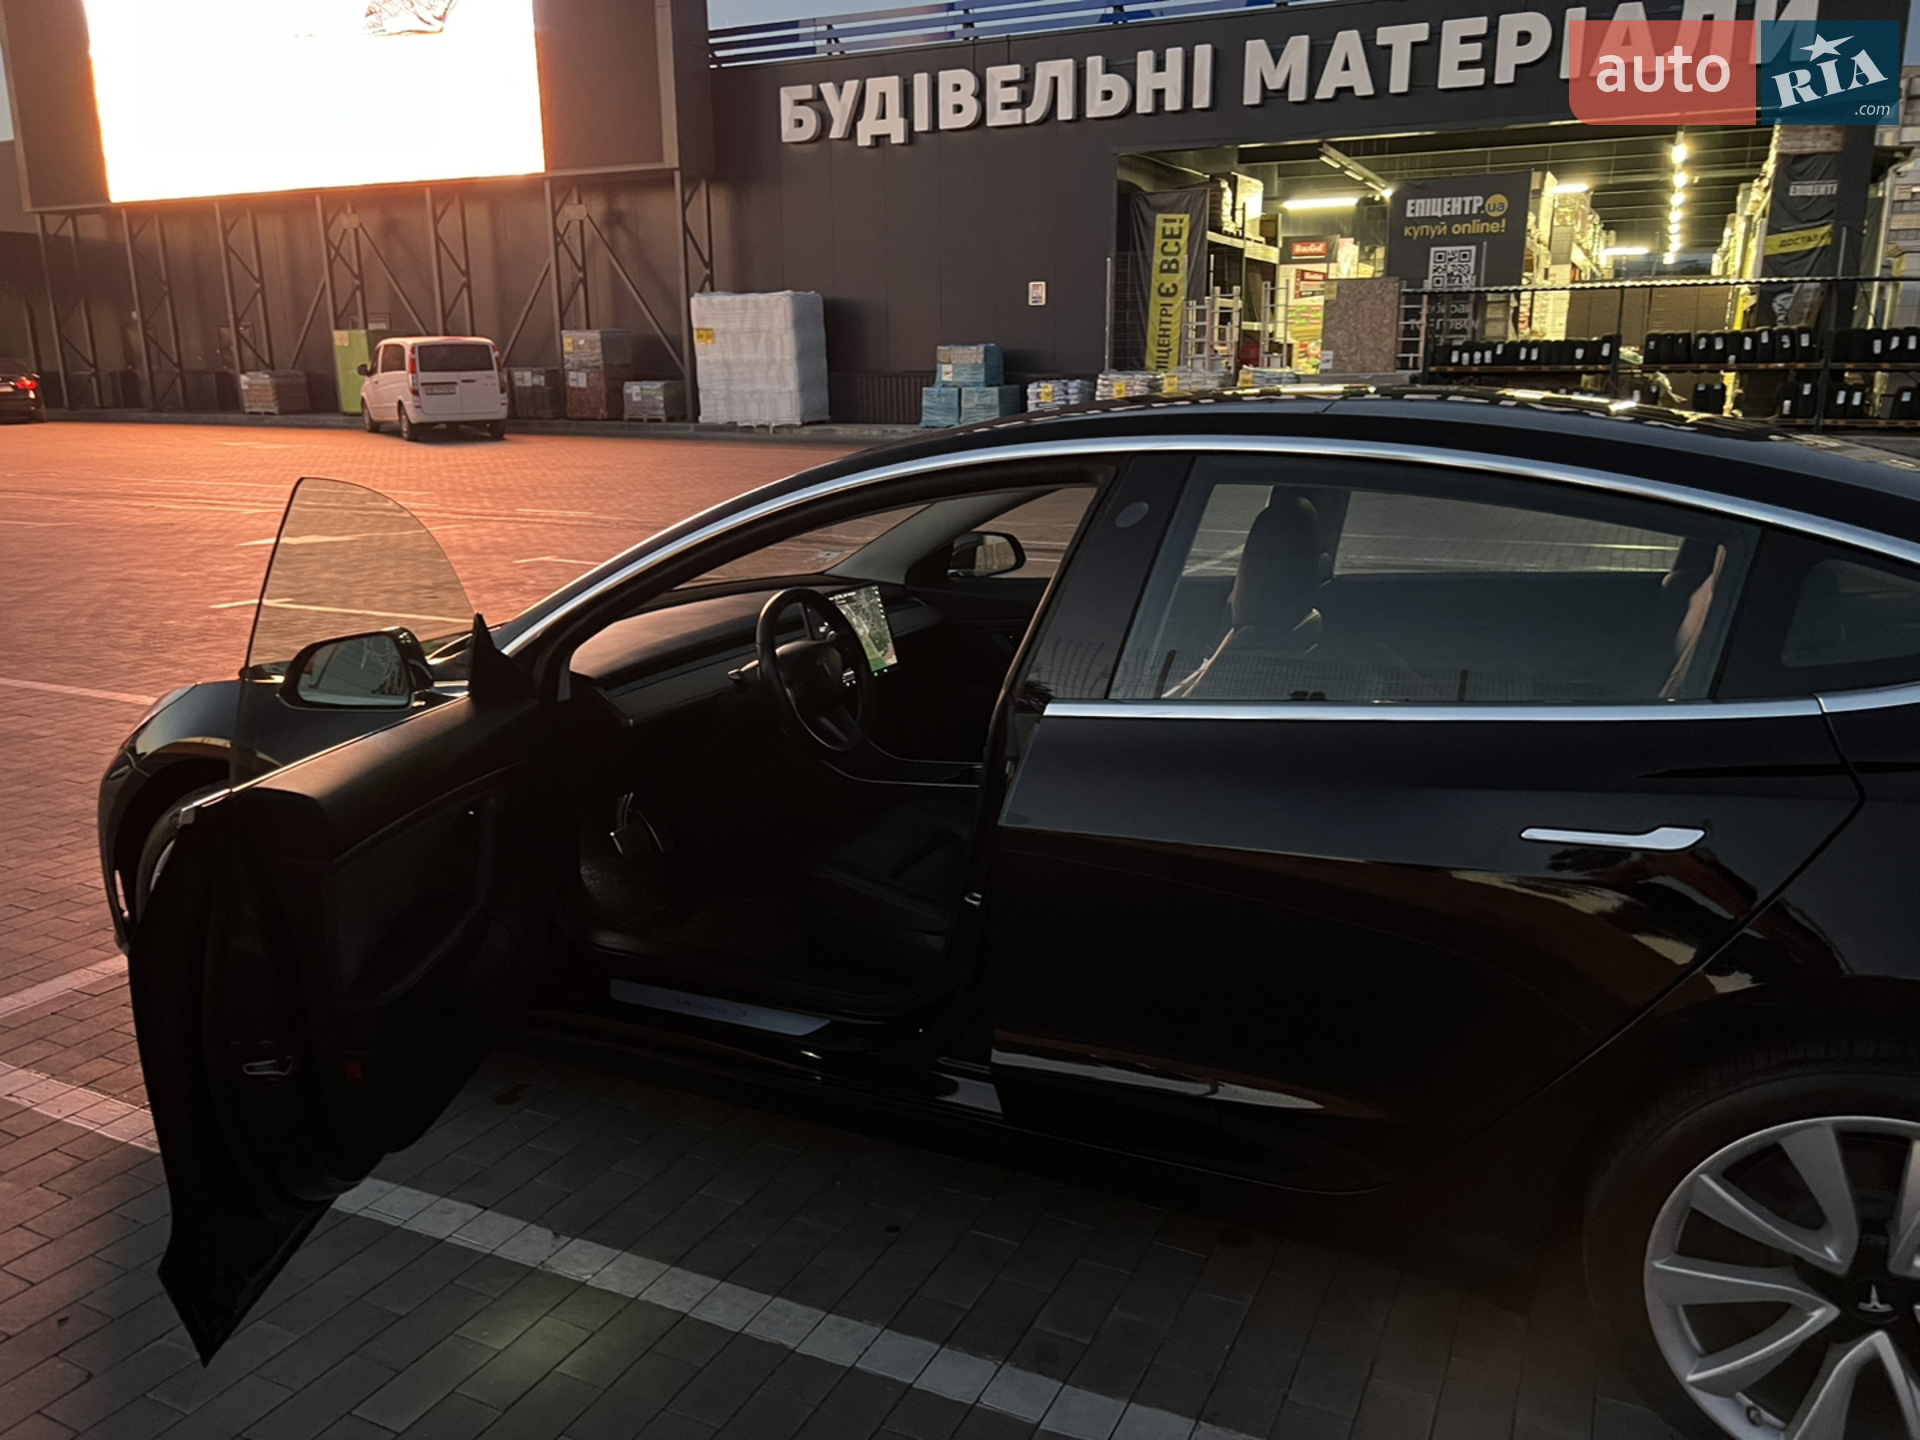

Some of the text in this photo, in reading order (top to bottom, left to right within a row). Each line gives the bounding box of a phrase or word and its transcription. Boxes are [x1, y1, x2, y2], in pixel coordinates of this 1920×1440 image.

[781, 0, 1820, 147] БУДІВЕЛЬНІ МАТЕРІАЛИ
[1159, 218, 1184, 274] ВСЕ!
[1404, 218, 1506, 240] купуй online!
[1157, 282, 1178, 298] Є
